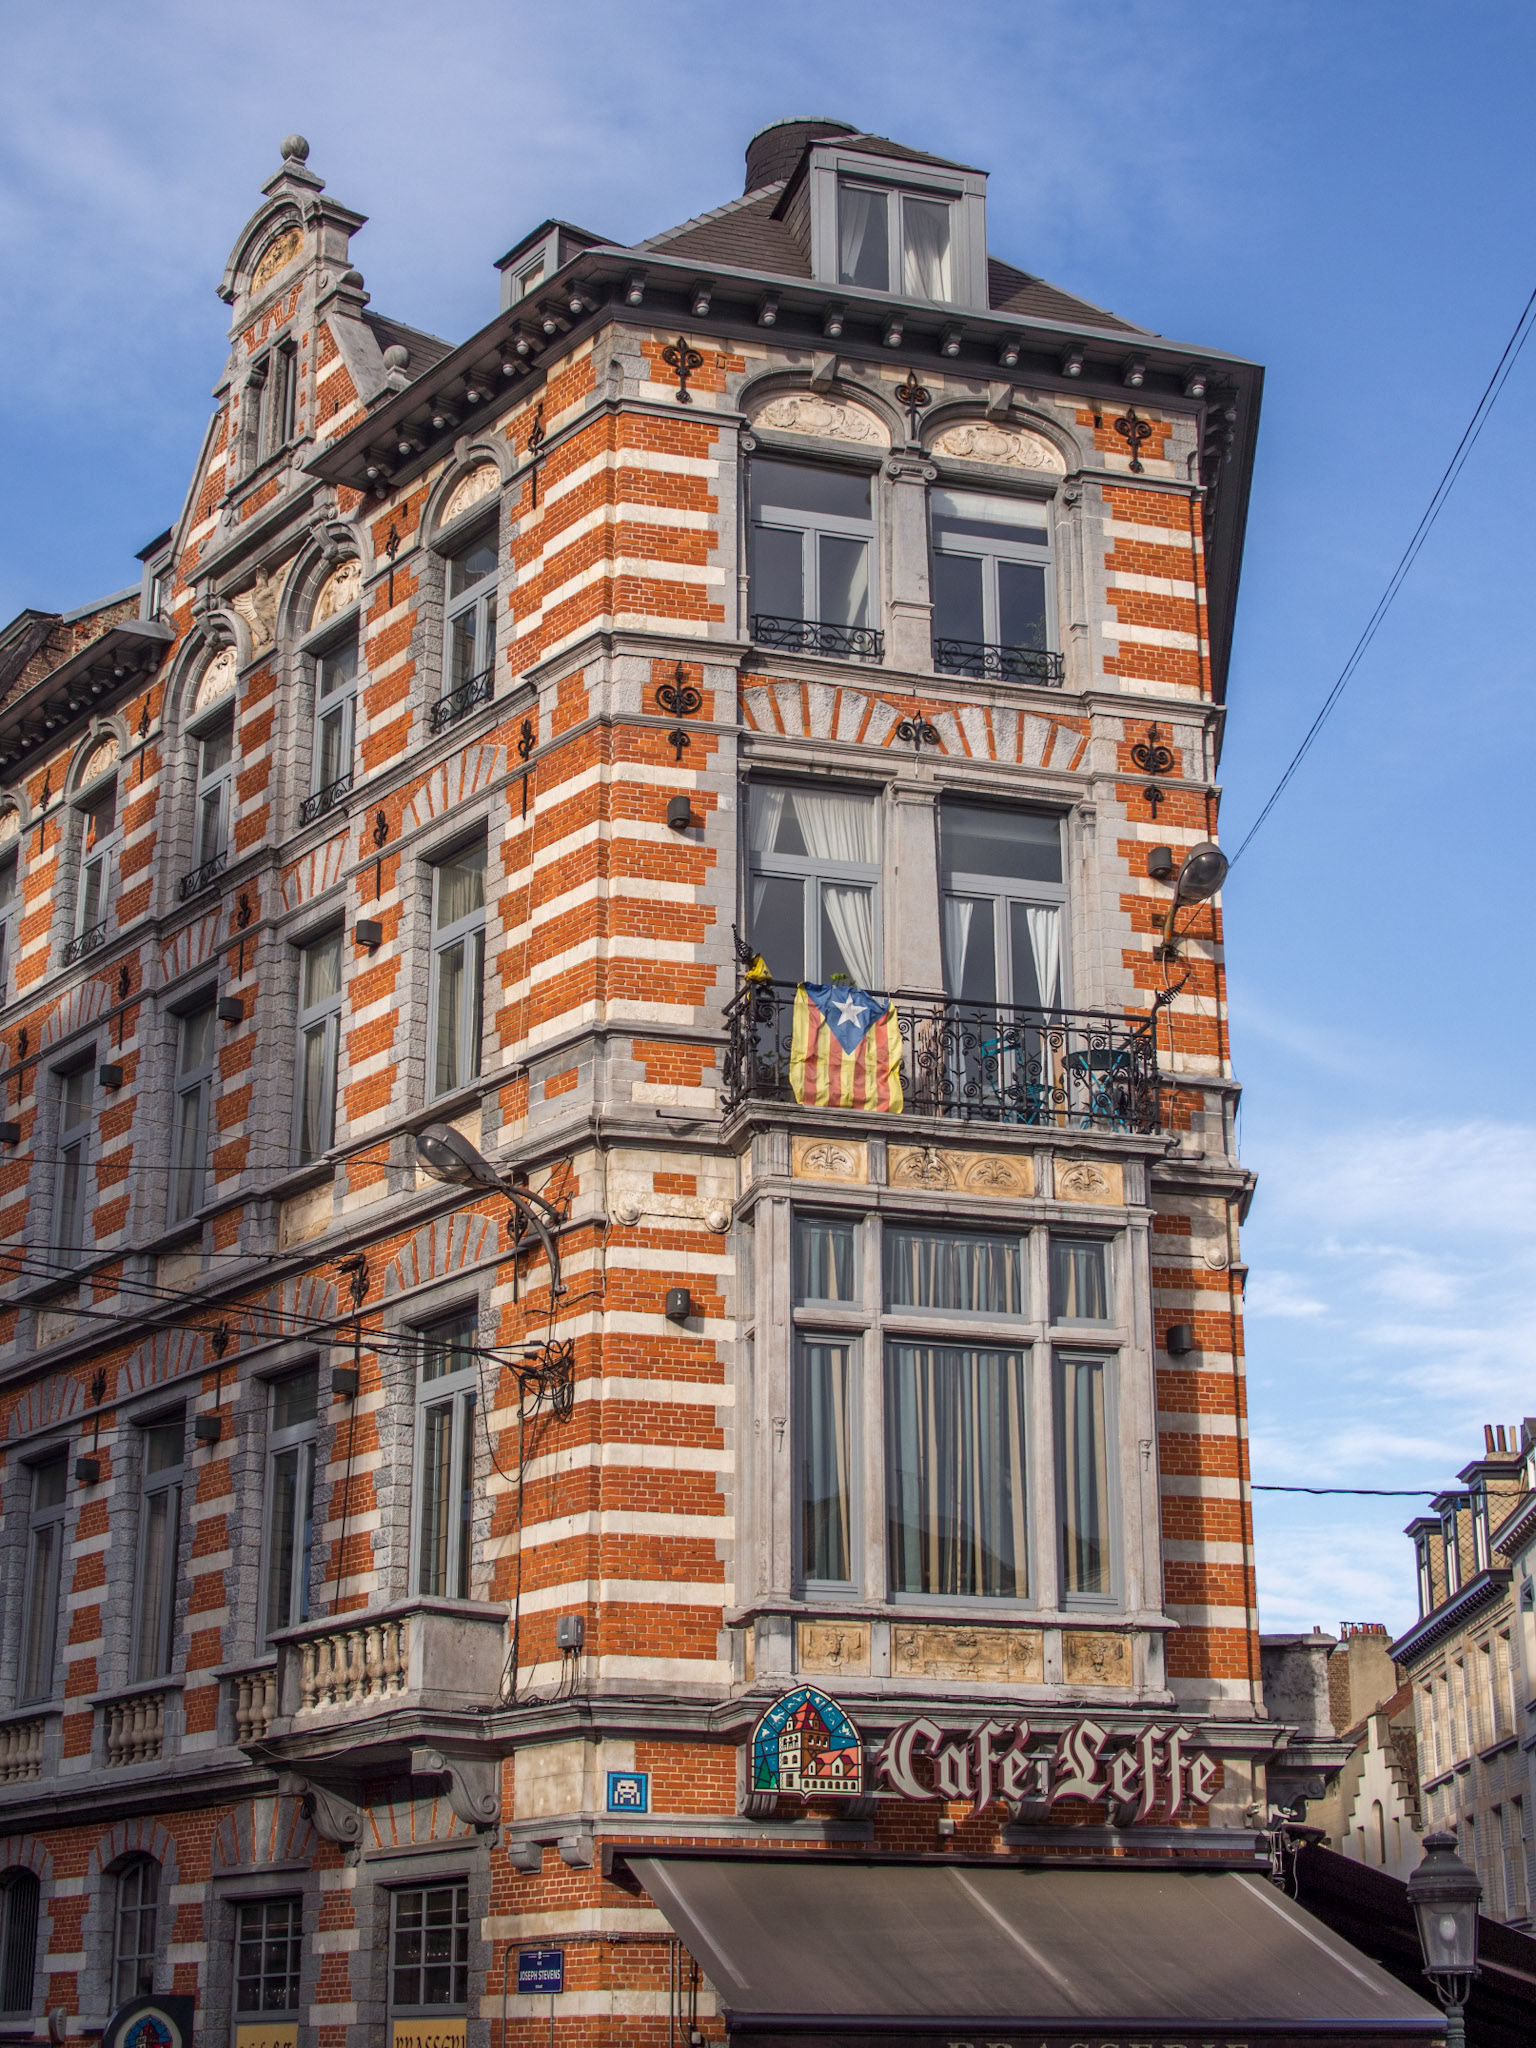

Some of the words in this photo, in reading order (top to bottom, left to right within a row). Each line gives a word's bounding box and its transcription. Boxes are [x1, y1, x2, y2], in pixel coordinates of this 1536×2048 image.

[875, 1716, 1034, 1818] Café
[1048, 1717, 1224, 1822] Leffe
[519, 1970, 538, 1981] JOSEPH
[538, 1969, 561, 1980] STEVENS
